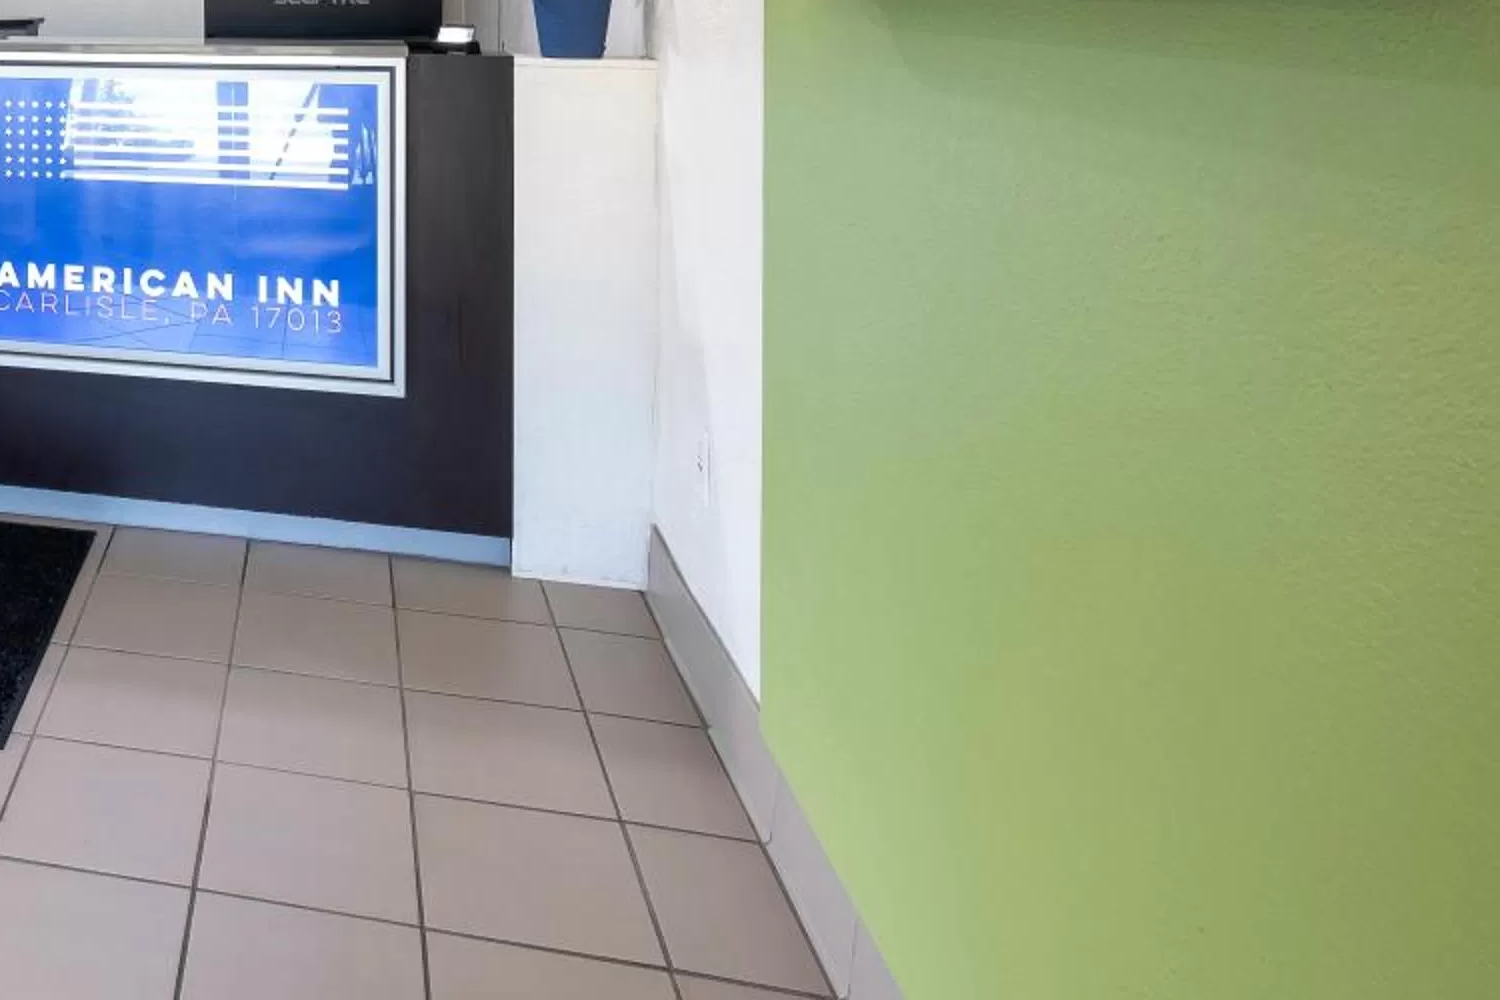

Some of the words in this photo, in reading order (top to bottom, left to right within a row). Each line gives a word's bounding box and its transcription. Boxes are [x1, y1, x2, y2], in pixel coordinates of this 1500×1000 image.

[257, 274, 340, 308] INN
[189, 301, 234, 327] PA
[250, 306, 342, 335] 17013
